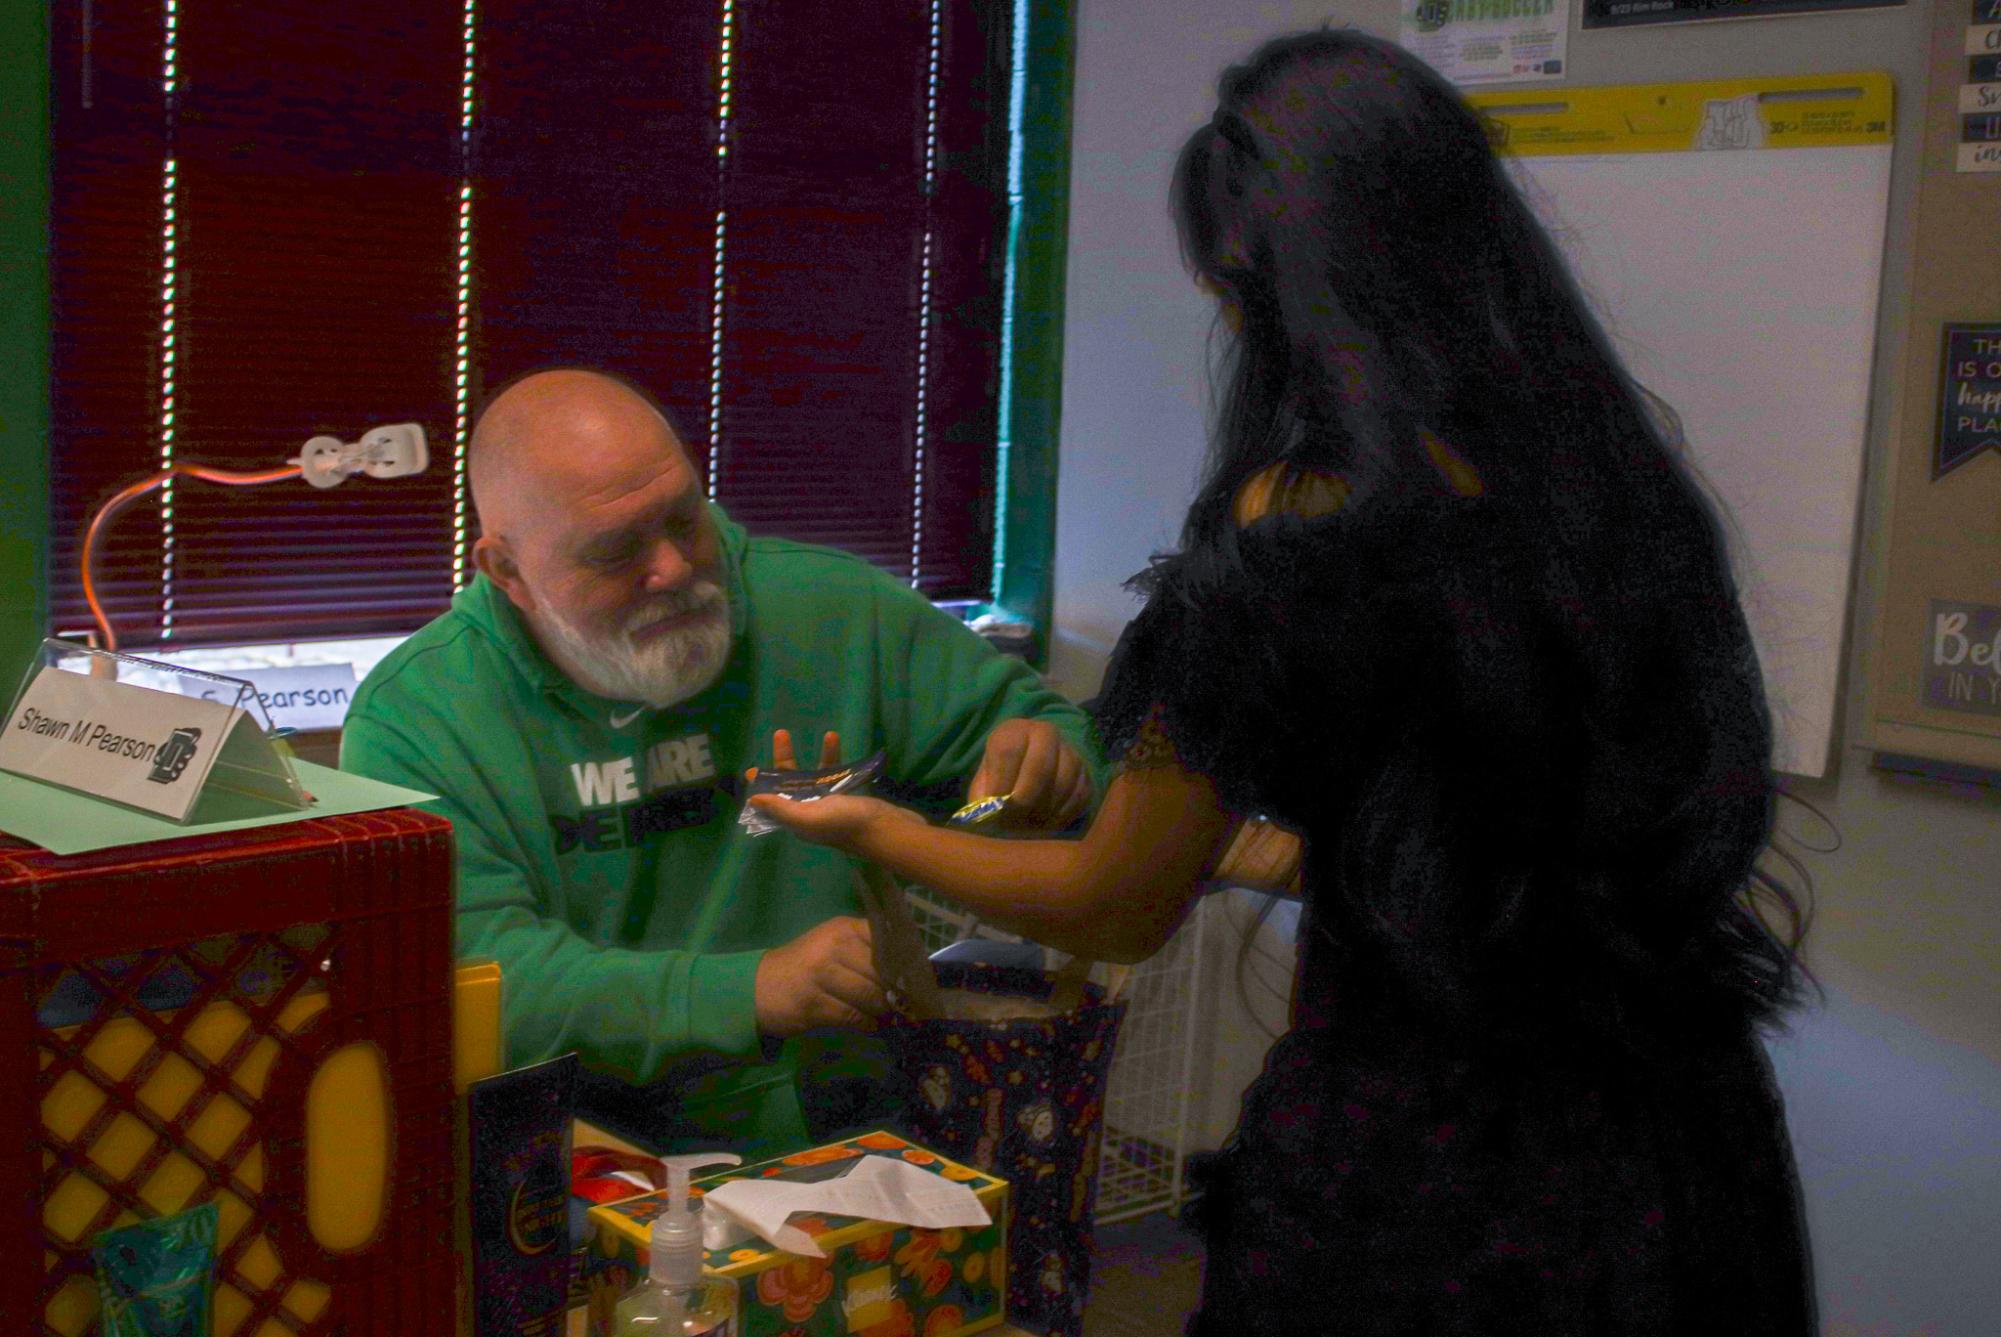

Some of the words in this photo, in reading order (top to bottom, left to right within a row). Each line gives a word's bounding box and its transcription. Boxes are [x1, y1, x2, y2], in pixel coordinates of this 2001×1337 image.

[1957, 361, 1978, 378] IS
[236, 687, 349, 709] Pearson
[1948, 671, 1973, 701] IN
[18, 707, 70, 740] Shawn
[69, 720, 92, 745] M
[87, 725, 156, 762] Pearson
[570, 756, 640, 807] WE
[646, 733, 717, 788] ARE
